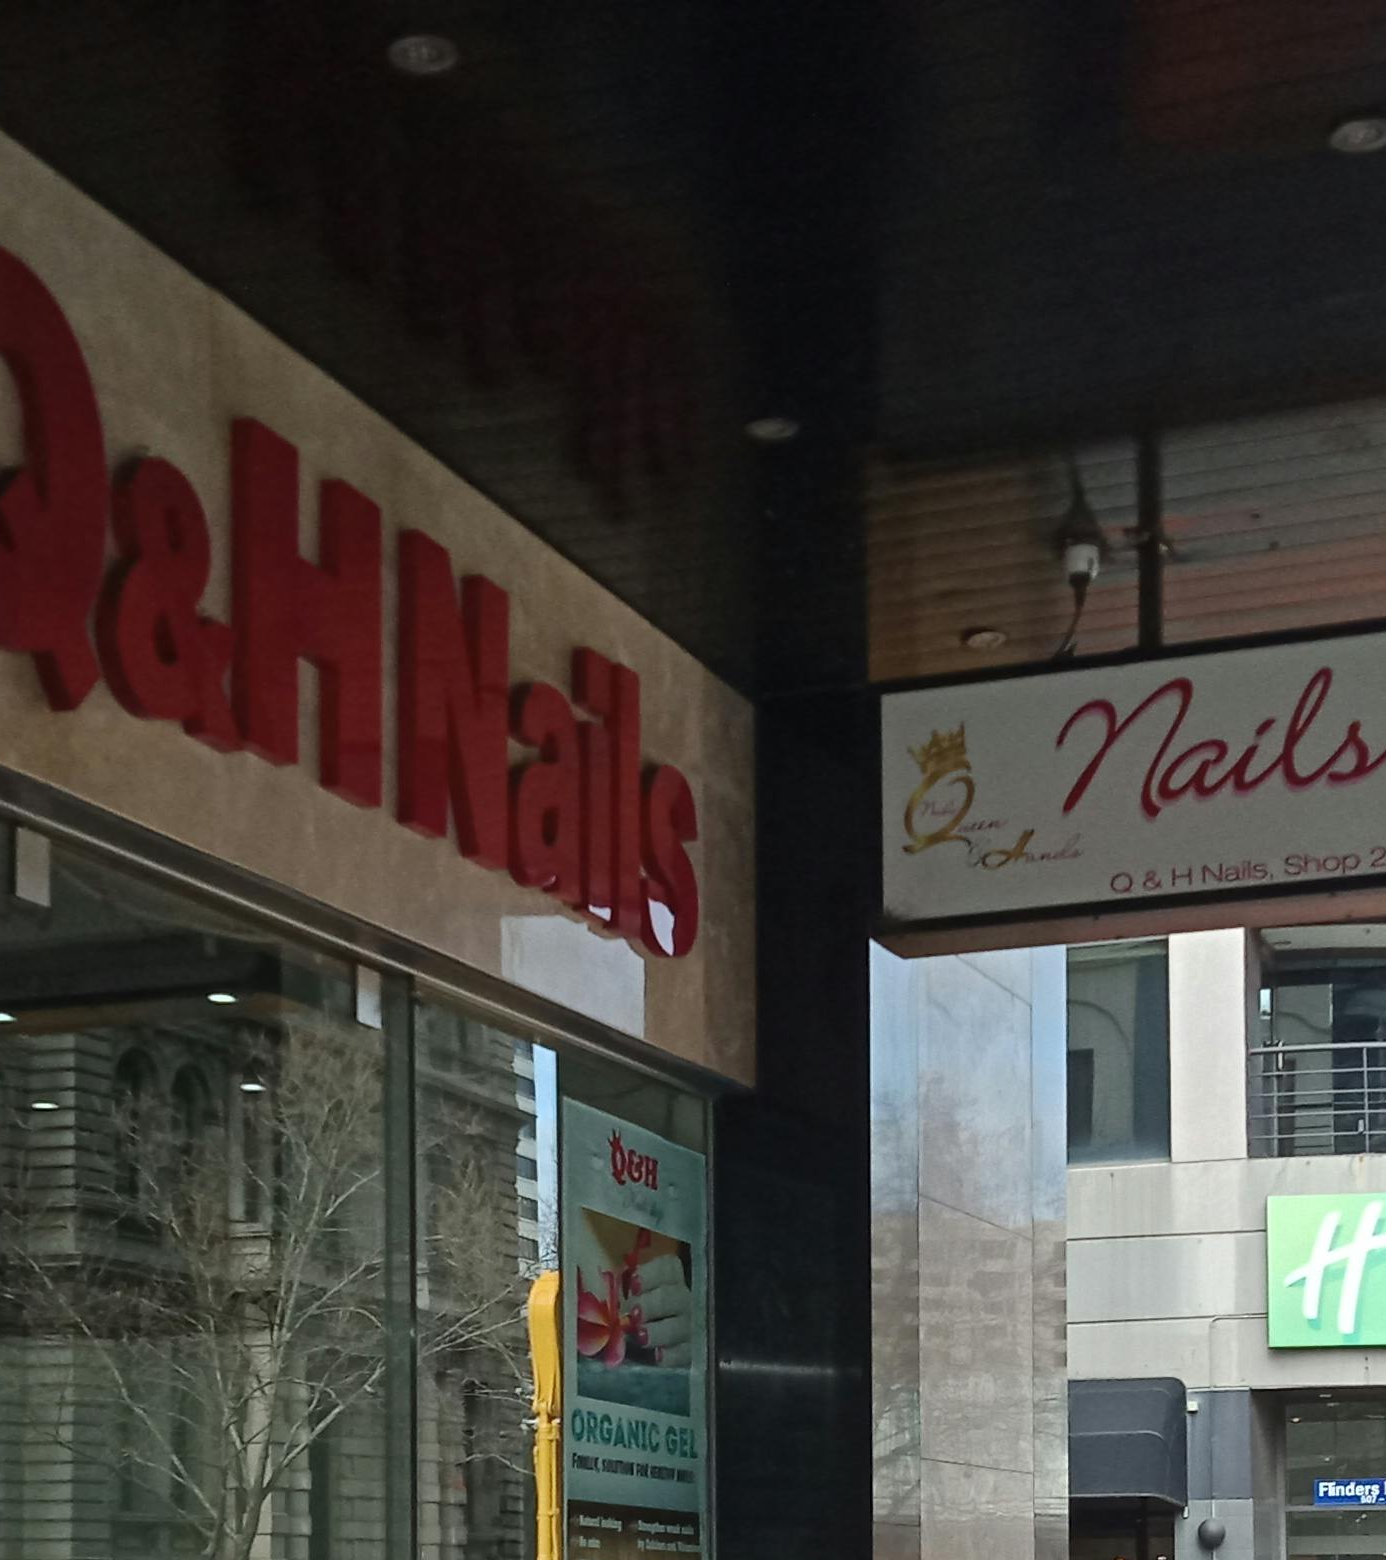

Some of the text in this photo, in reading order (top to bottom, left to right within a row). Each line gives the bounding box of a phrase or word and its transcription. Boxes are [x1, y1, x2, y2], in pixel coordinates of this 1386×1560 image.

[395, 528, 699, 957] Nails
[1142, 868, 1163, 890] &
[1171, 866, 1193, 888] H
[1202, 860, 1273, 884] Nails,
[1284, 852, 1360, 876] Shop
[571, 1408, 698, 1459] ORGANIC GEL
[1318, 1481, 1380, 1497] Flinders
